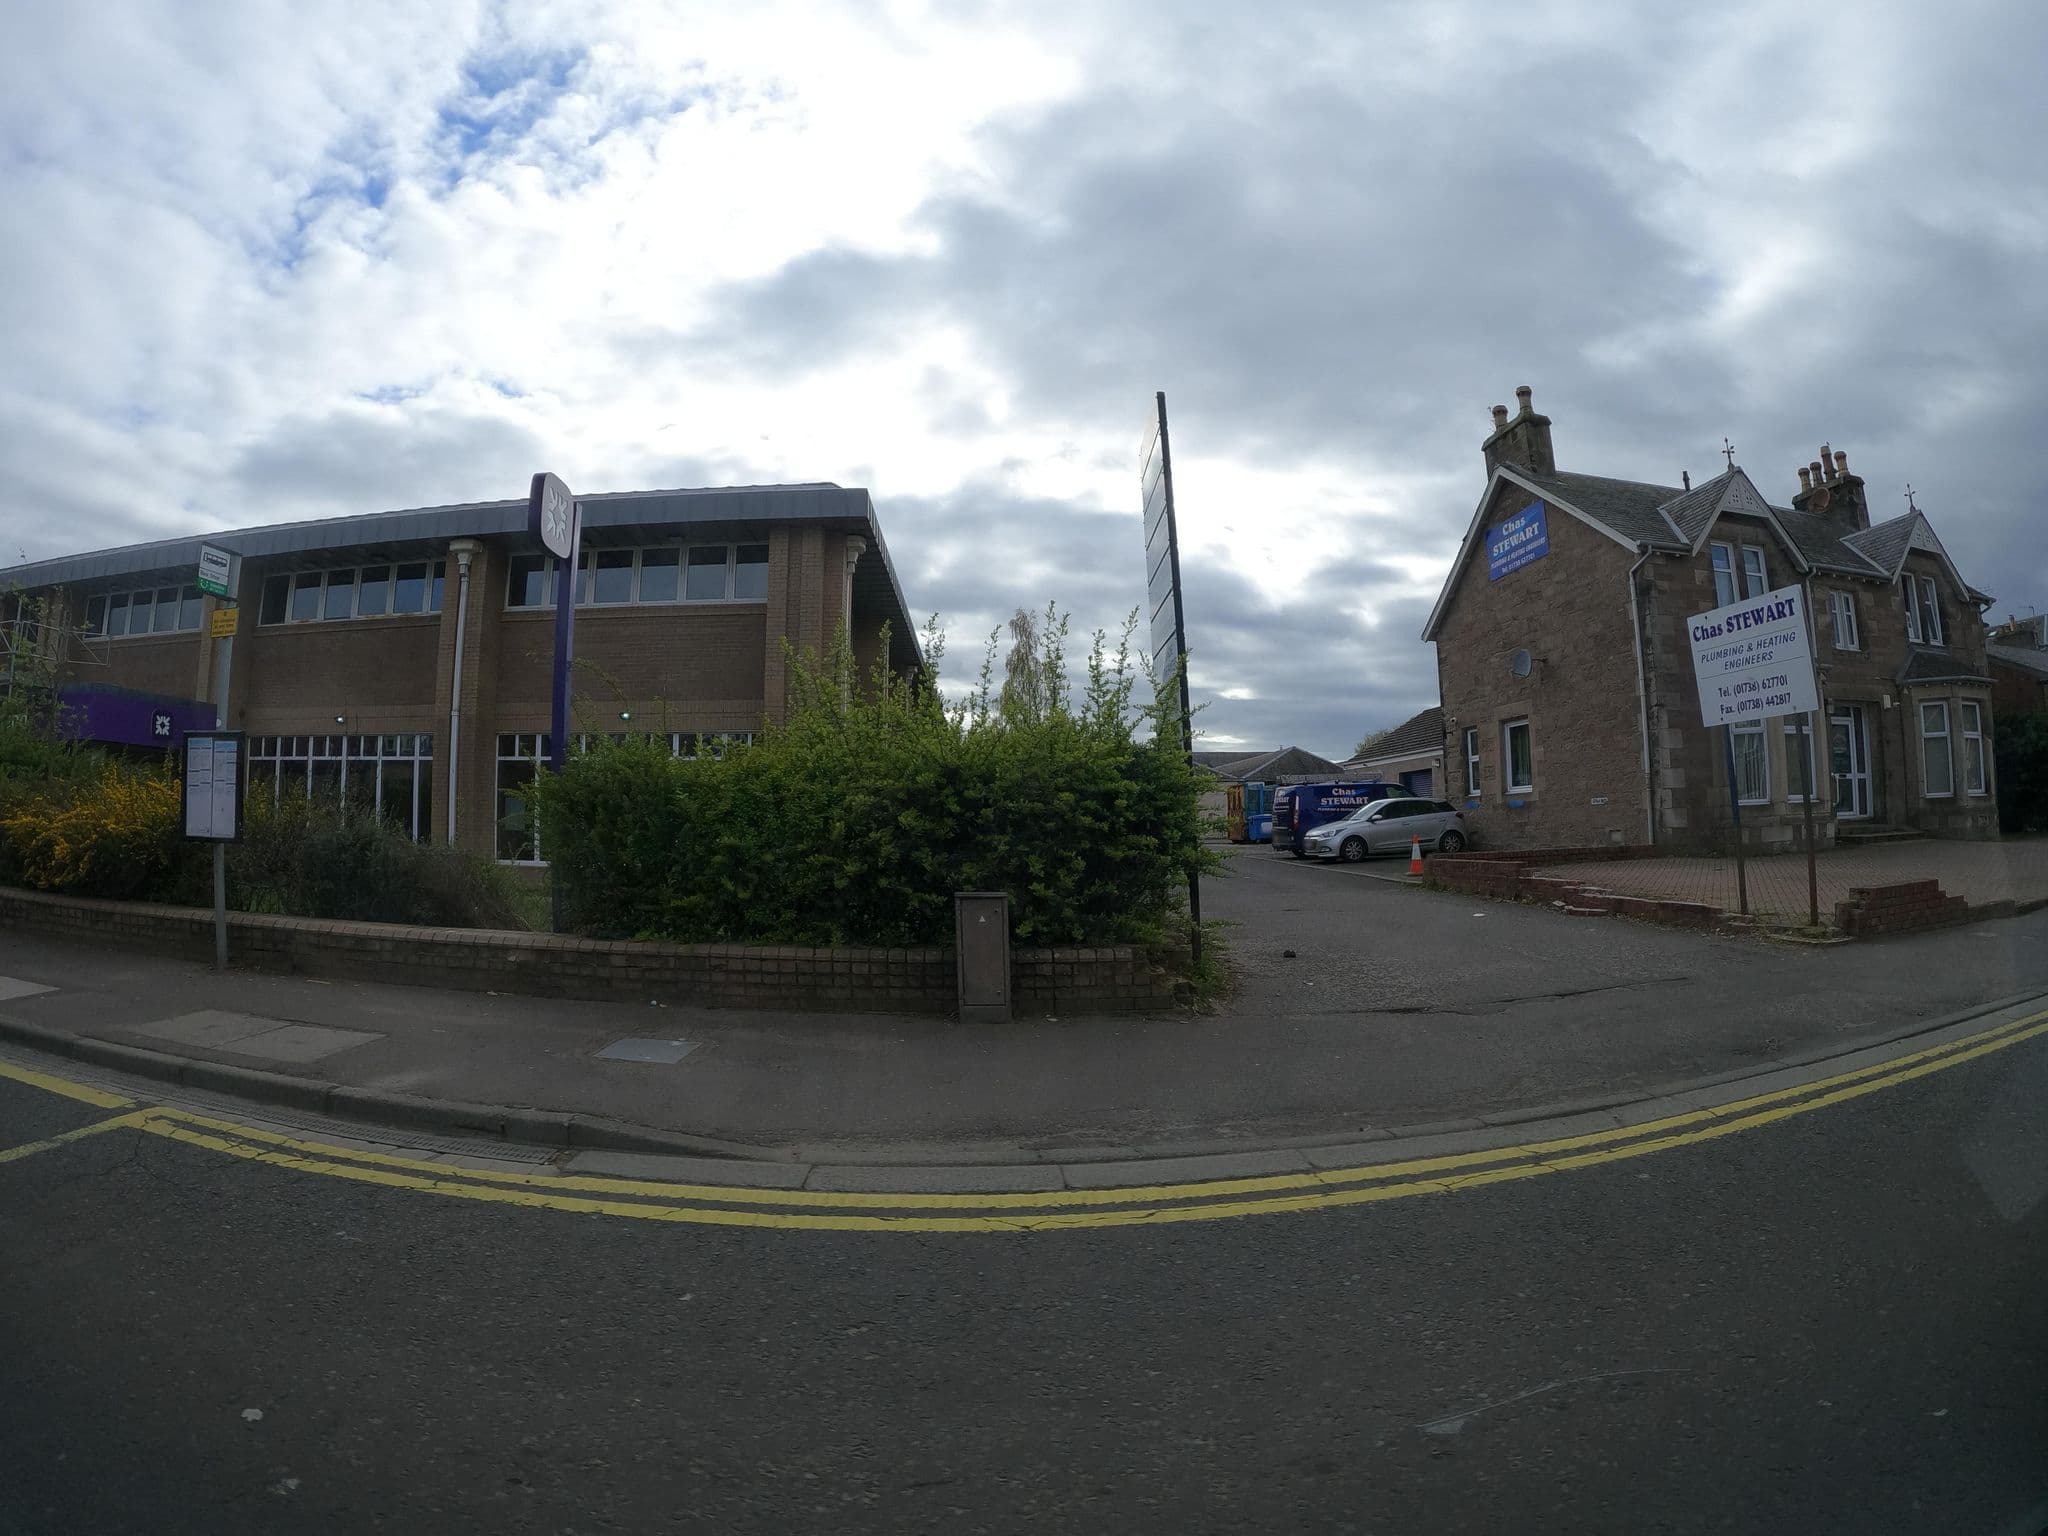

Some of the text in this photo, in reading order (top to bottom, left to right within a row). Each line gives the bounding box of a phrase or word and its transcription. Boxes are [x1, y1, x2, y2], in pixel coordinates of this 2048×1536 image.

[1502, 516, 1526, 536] Chas
[1492, 522, 1540, 557] STEWART
[1693, 598, 1795, 642] Chas STEWART
[1701, 632, 1796, 664] PLUMBING & HEATING
[1724, 651, 1774, 671] ENGINEERS
[1718, 674, 1788, 698] Tel. (01738) 627701
[1720, 692, 1791, 715] Fax. (01738) 442817
[1320, 796, 1369, 806] STEWART
[1332, 787, 1356, 796] Chas
